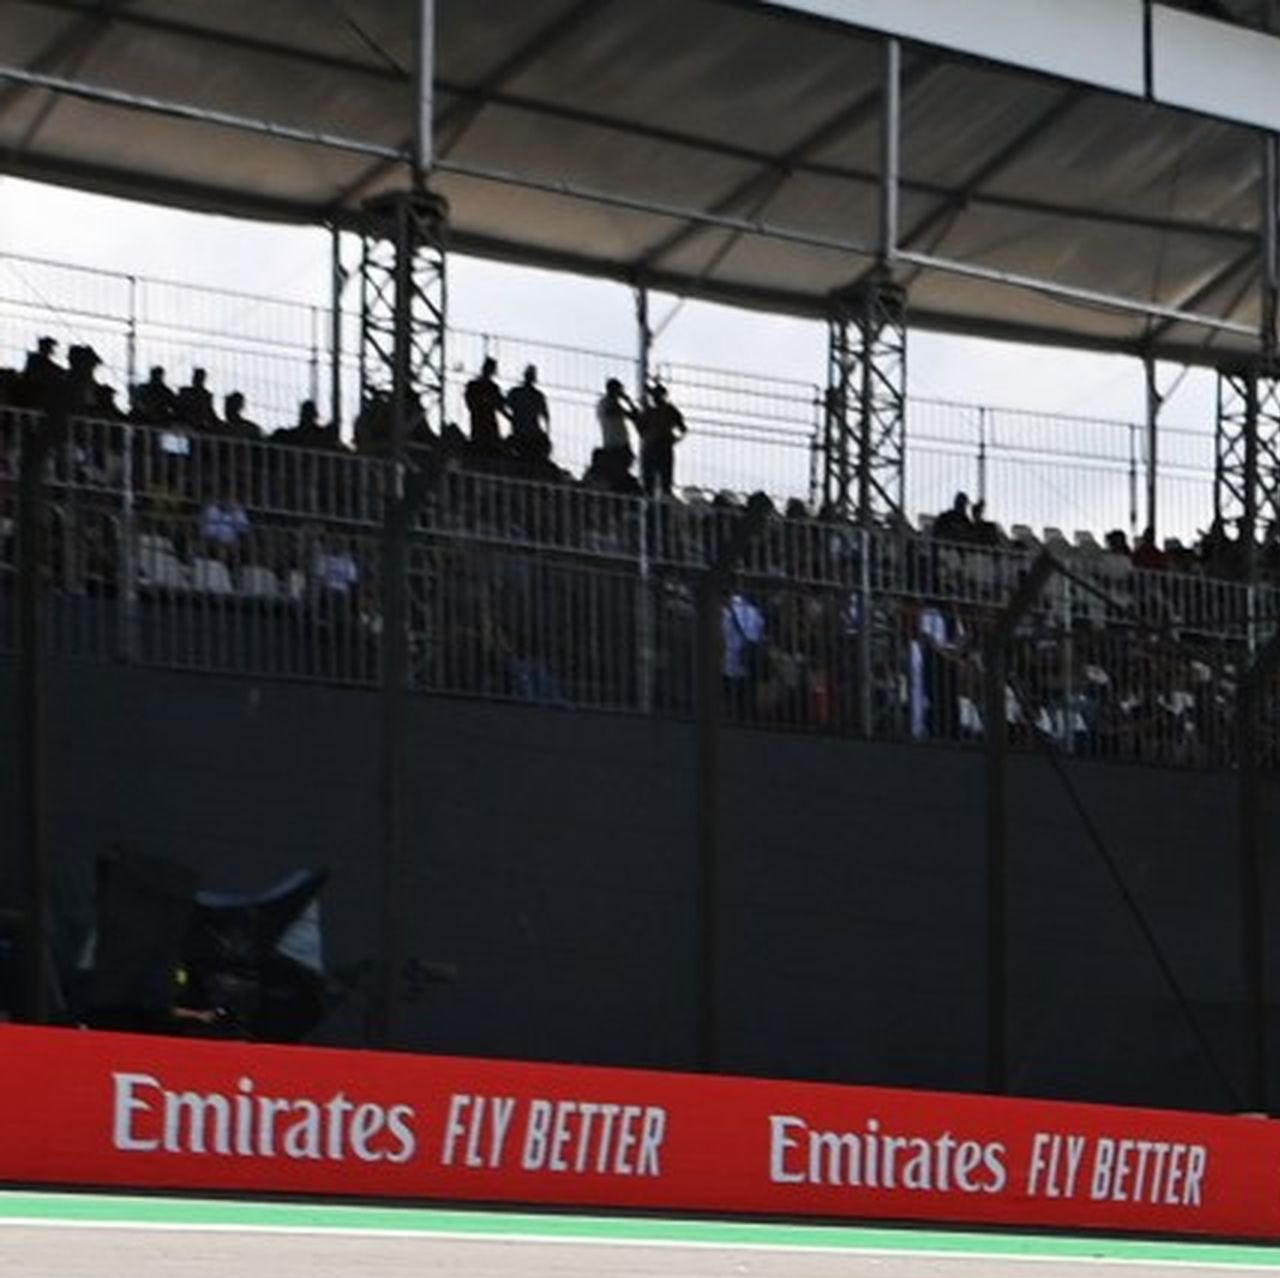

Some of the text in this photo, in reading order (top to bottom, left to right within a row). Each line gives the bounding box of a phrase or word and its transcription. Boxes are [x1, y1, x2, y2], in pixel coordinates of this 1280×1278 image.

[112, 1072, 667, 1177] Emirates FLY BETTER
[769, 1115, 1207, 1207] Emirates FLY BETTER
